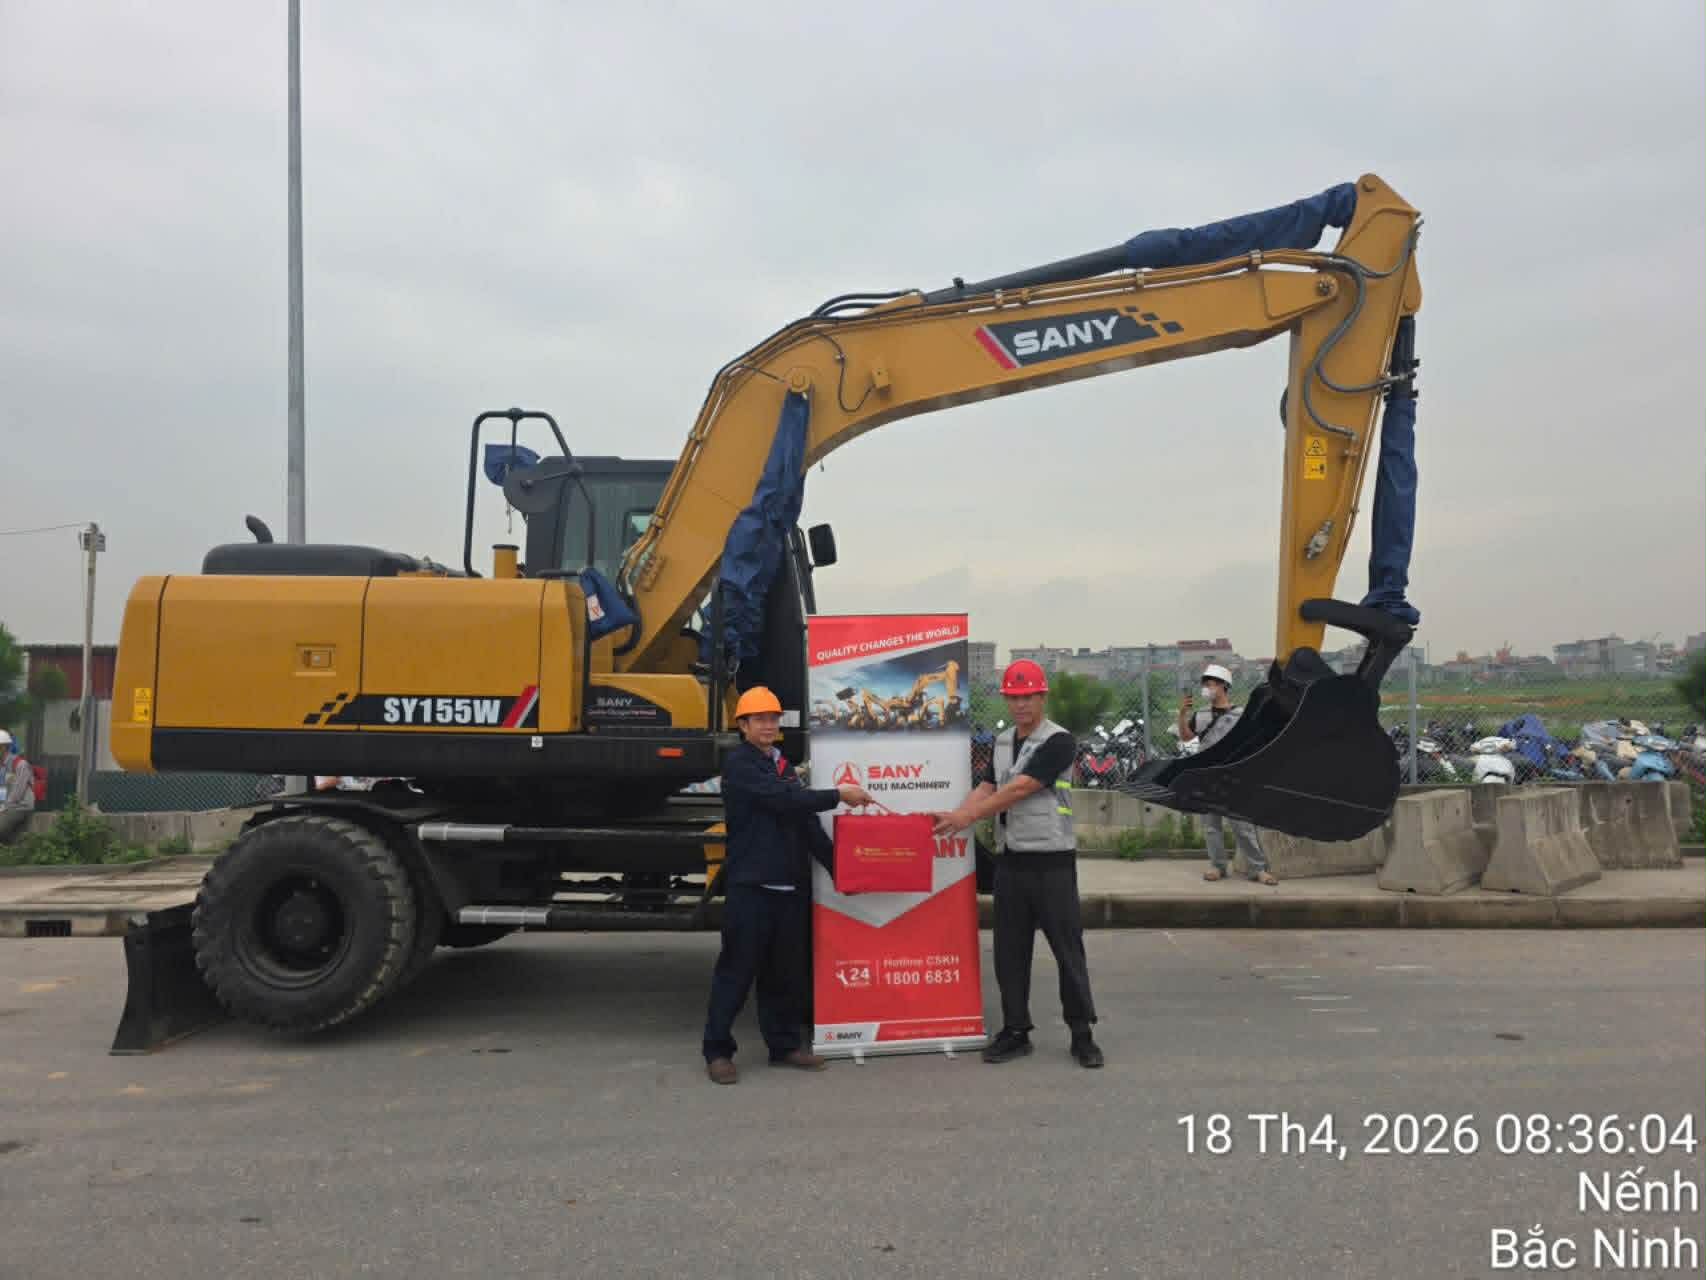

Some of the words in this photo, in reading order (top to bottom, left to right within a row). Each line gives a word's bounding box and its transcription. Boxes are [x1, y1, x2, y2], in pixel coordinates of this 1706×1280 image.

[1013, 315, 1119, 356] SANY
[816, 643, 858, 661] QUALITY
[859, 634, 905, 653] CHANGES
[905, 631, 925, 644] THE
[925, 624, 960, 641] WORLD
[383, 697, 501, 725] SY155W
[867, 764, 924, 780] SANY
[891, 780, 950, 791] MACHINERY
[849, 967, 871, 981] 24
[884, 971, 920, 985] 1800
[924, 969, 960, 984] 6831
